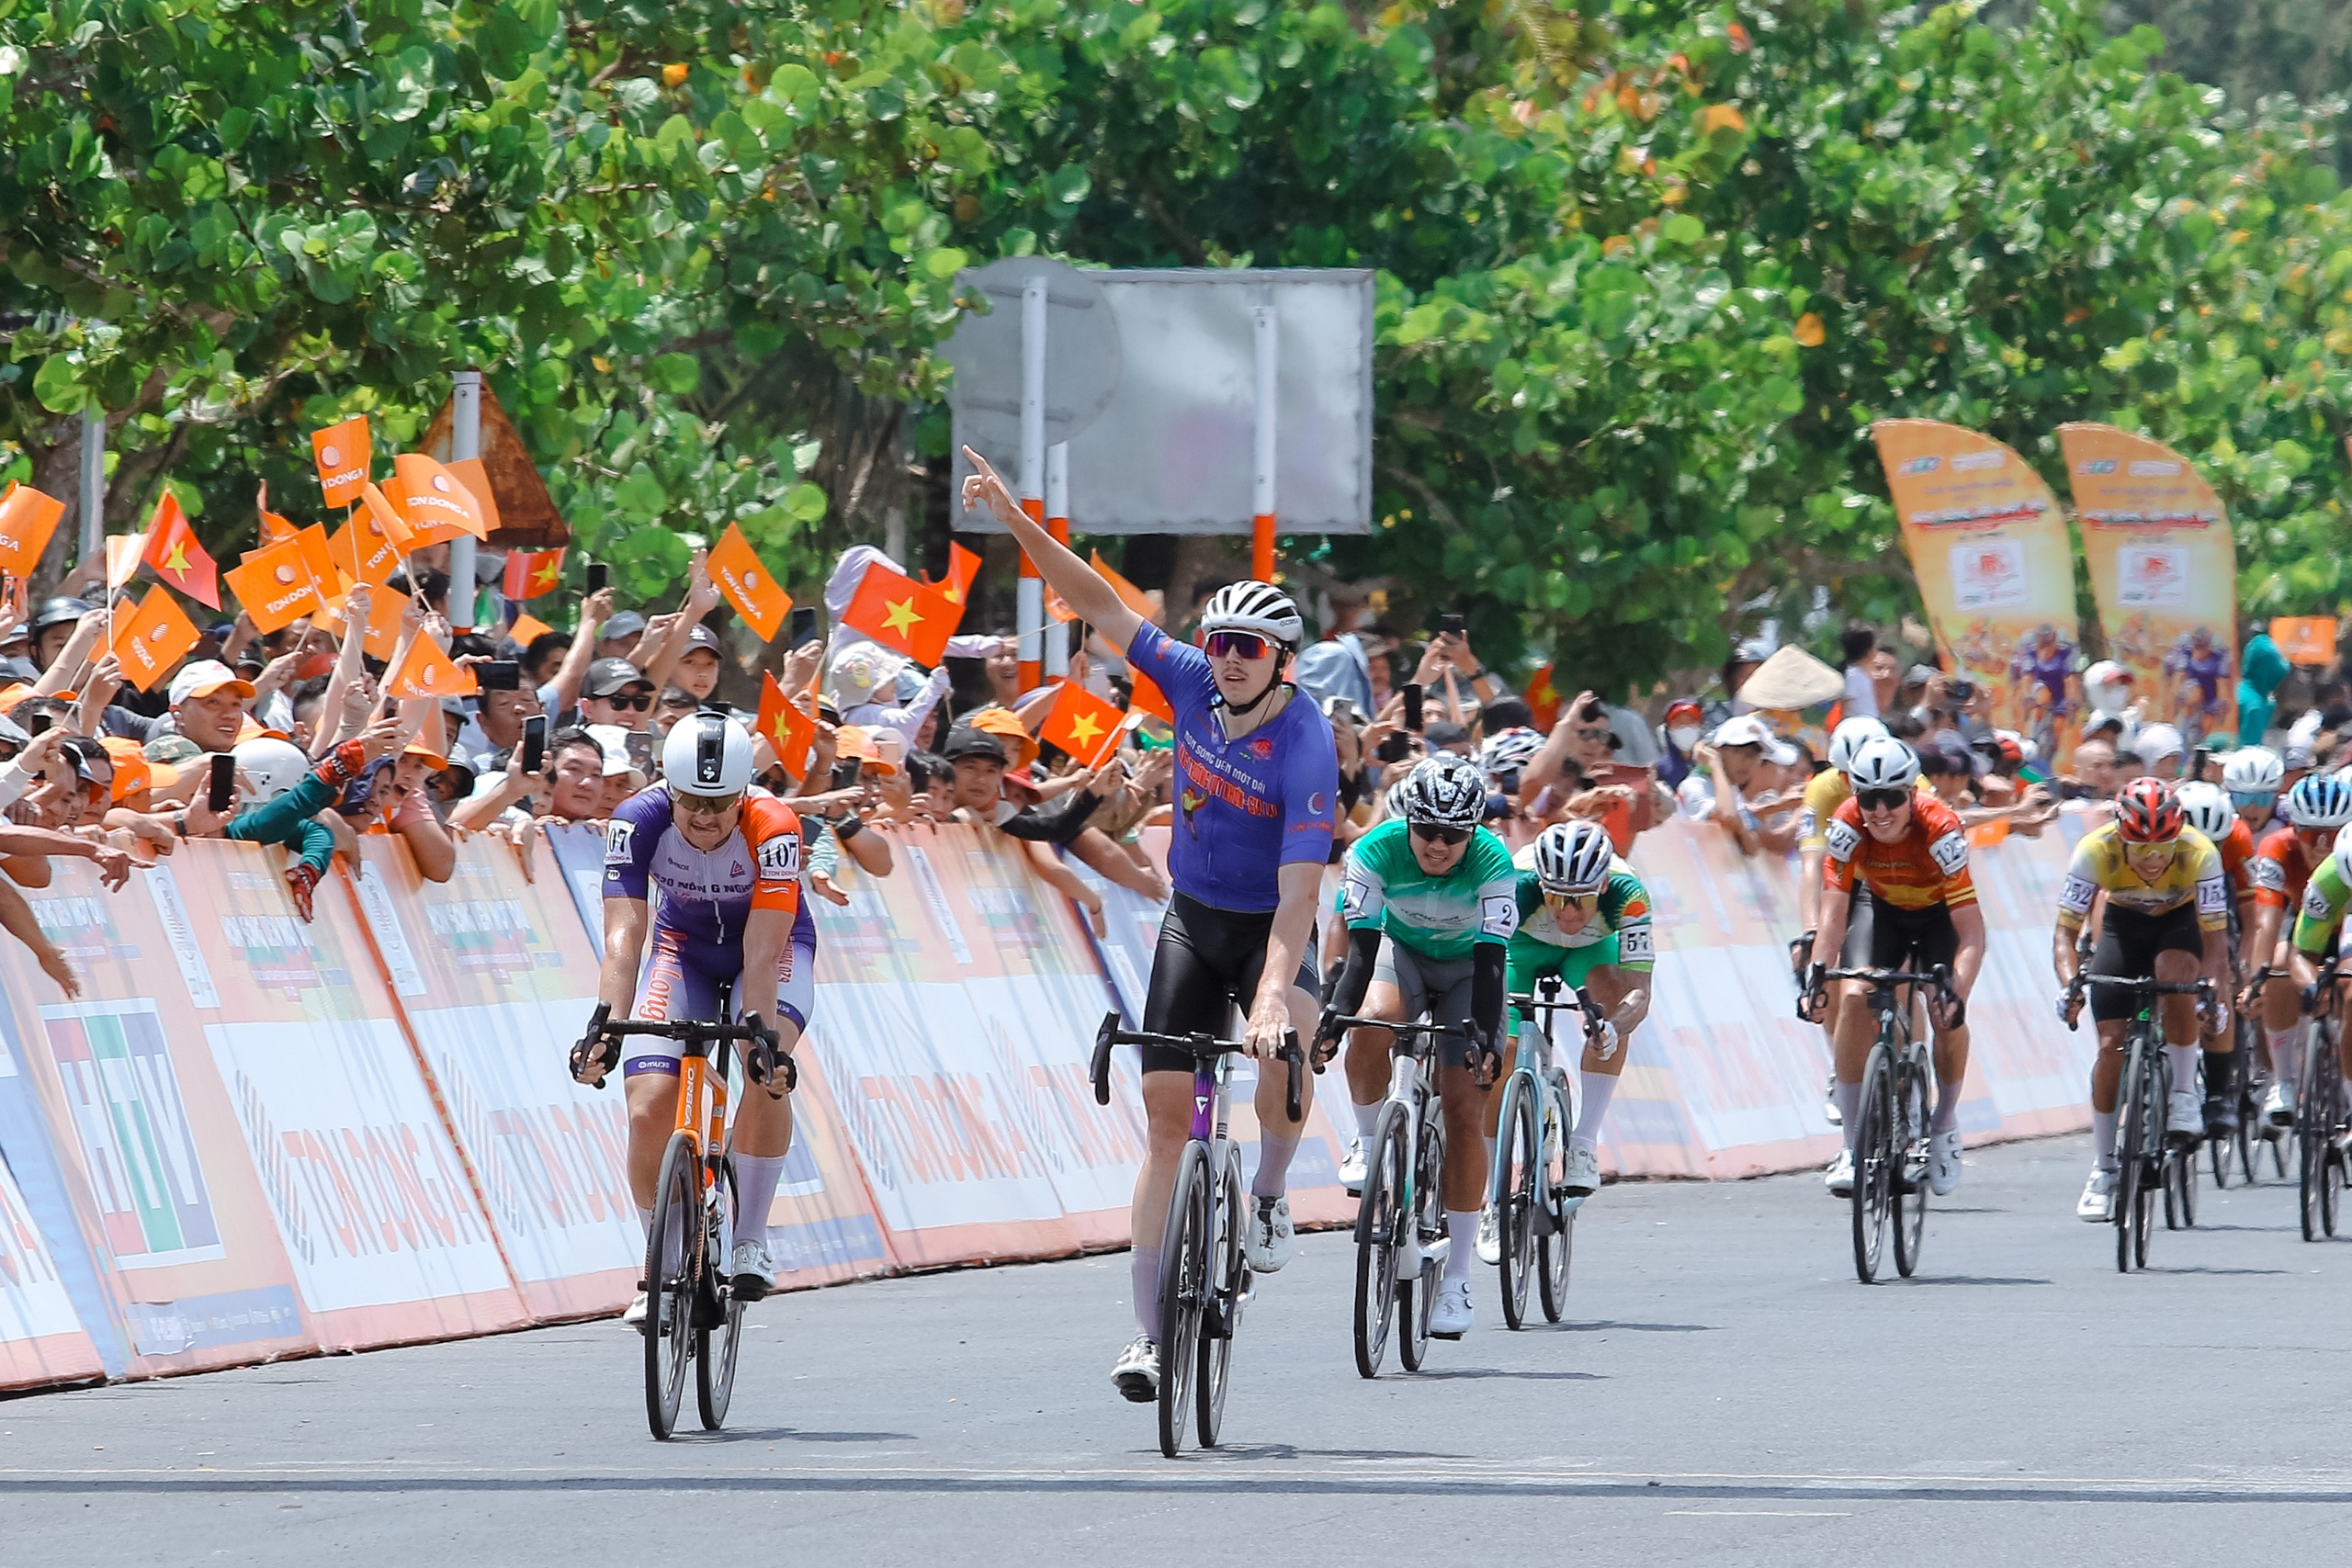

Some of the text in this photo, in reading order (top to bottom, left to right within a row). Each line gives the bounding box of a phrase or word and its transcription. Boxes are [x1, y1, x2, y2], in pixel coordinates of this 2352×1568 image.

[609, 828, 628, 852] 07
[763, 842, 797, 868] 107
[1500, 904, 1512, 927] 2
[1627, 931, 1647, 953] 57
